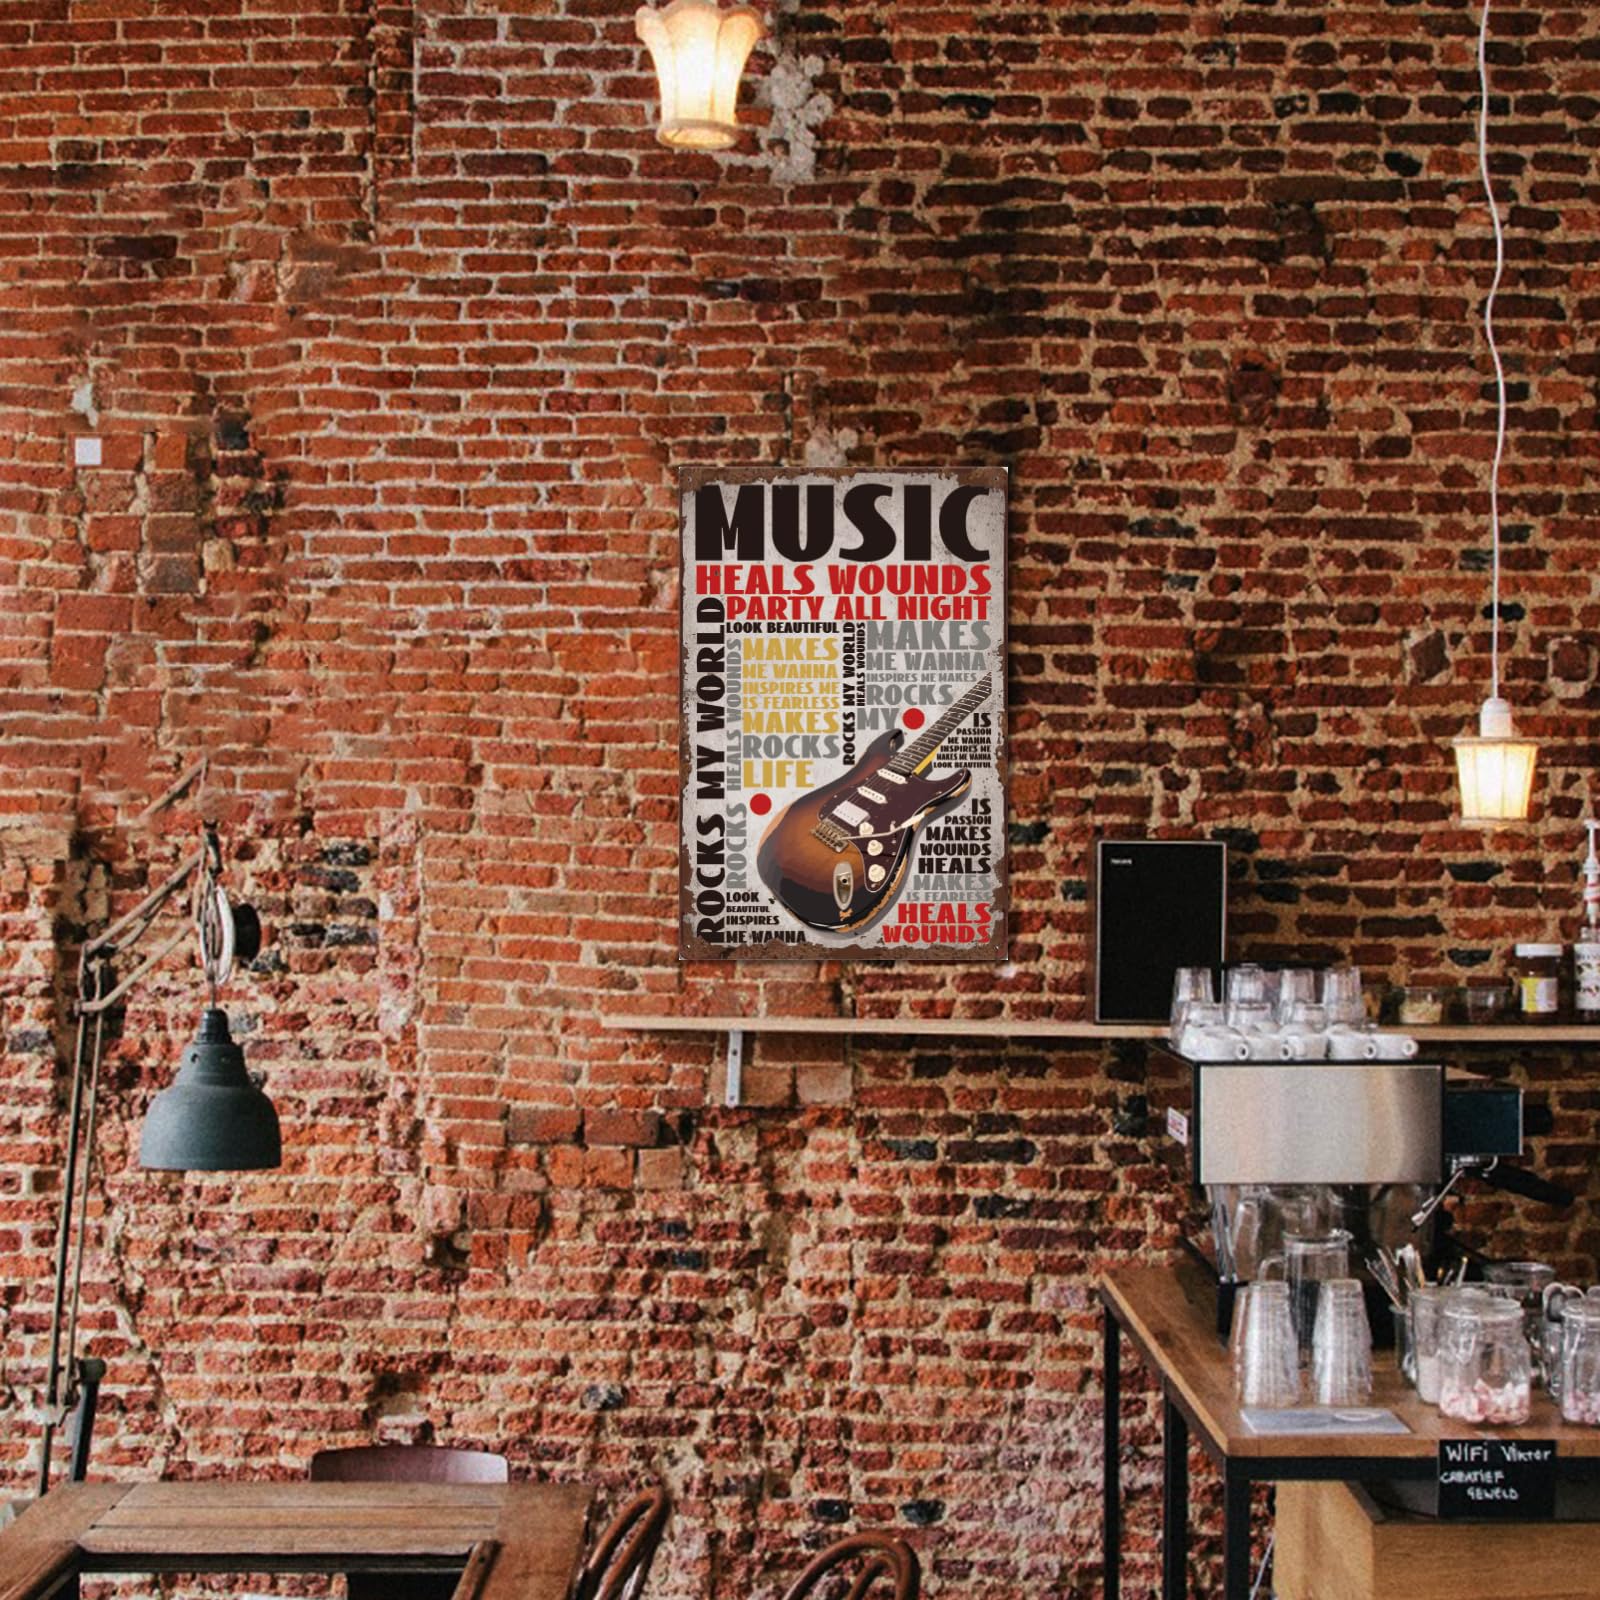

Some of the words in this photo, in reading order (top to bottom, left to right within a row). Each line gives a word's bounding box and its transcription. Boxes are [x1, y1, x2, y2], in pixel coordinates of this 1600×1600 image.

[695, 483, 990, 562] MUSIC
[696, 564, 815, 595] HEALS
[828, 564, 992, 595] WOUNDS
[727, 596, 831, 620] PARTY
[834, 596, 886, 620] ALL
[898, 596, 991, 620] NIGHT
[726, 622, 763, 633] LOOK
[767, 622, 840, 633] BEAUTIFUL
[867, 621, 991, 650] MAKES
[743, 638, 839, 661] MAKES
[843, 622, 856, 679] WORLD
[856, 622, 865, 669] WOUNDS
[697, 597, 725, 731] WORLD
[743, 664, 769, 678] ME
[773, 664, 838, 678] WANNA
[867, 652, 896, 670] ME
[904, 652, 986, 670] WANNA
[726, 639, 741, 723] WOUNDS
[867, 673, 918, 683] INSPIRES
[921, 673, 936, 682] ME
[939, 673, 977, 682] MAKES
[743, 682, 812, 695] INSPIRES
[819, 682, 839, 694] ME
[843, 682, 856, 707] MY
[856, 672, 865, 707] HEALS
[866, 684, 954, 705] ROCKS
[743, 697, 759, 709] IS
[763, 697, 840, 709] FEARLESS
[743, 711, 840, 733] MAKES
[857, 707, 900, 730] MY
[973, 712, 991, 727] IS
[843, 711, 856, 765] ROCKS
[956, 728, 992, 736] PASSION
[743, 735, 840, 758] ROCKS
[940, 745, 978, 753] INSPIRES
[726, 729, 741, 791] HEALS
[936, 753, 958, 761] MAKES
[697, 746, 725, 800] MY
[743, 760, 814, 788] LIFE
[971, 798, 991, 815] IS
[945, 816, 991, 824] PASSION
[926, 826, 991, 841] MAKES
[726, 802, 747, 889] ROCKS
[919, 843, 991, 856] WOUNDS
[918, 858, 991, 873] HEALS
[696, 814, 725, 943] ROCKS
[913, 875, 991, 890] MAKES
[726, 892, 760, 903] LOOK
[906, 892, 920, 901] IS
[924, 892, 991, 901] FEARLESS
[726, 915, 780, 925] INSPIRES
[897, 903, 992, 923] HEALS
[726, 931, 747, 943] ME
[750, 931, 807, 943] WANNA
[882, 925, 991, 943] WOUNDS
